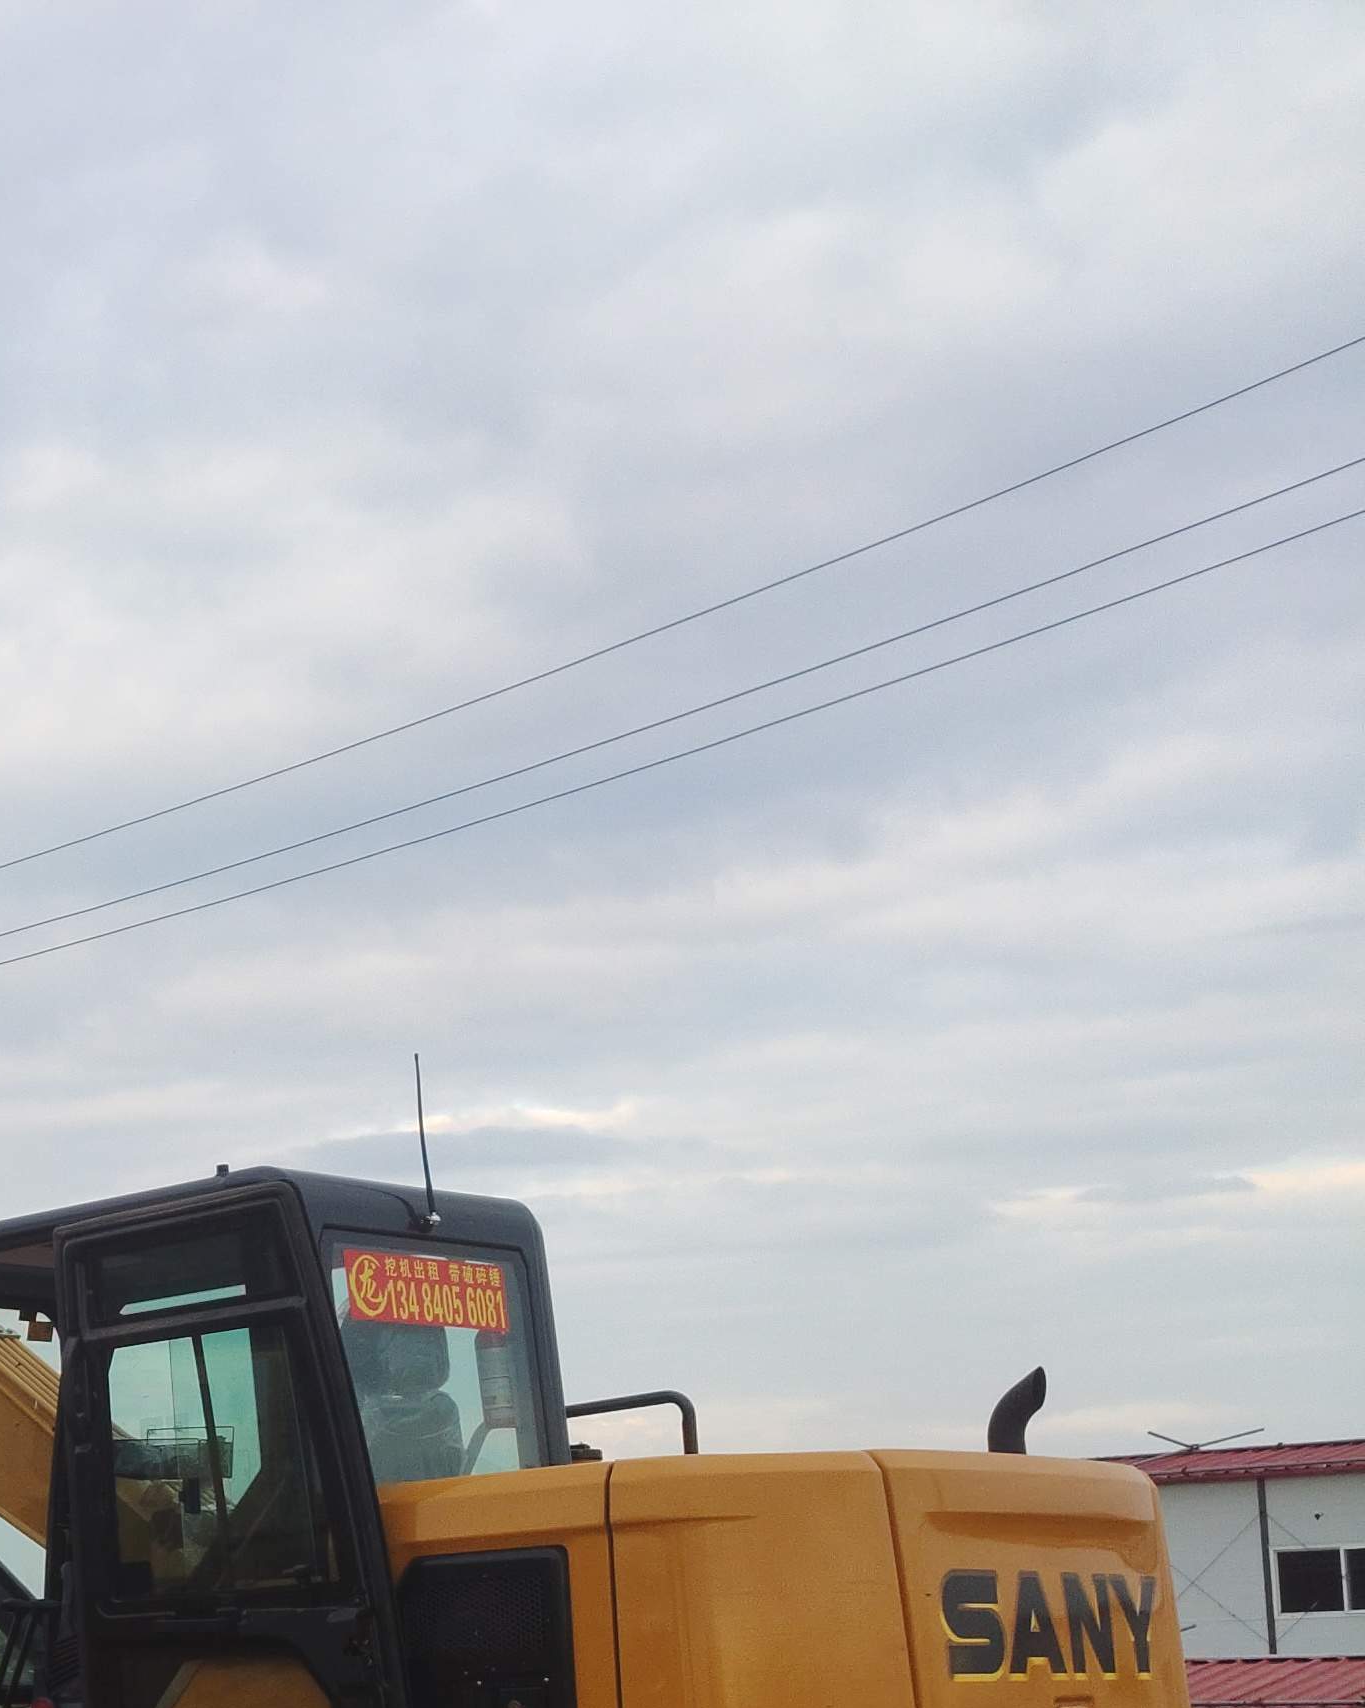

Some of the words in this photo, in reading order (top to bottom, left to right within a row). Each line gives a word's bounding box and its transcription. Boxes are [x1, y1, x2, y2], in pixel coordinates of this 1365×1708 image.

[385, 1256, 440, 1280] 挖机出租
[386, 1279, 420, 1321] 134
[422, 1282, 464, 1325] 8405
[466, 1287, 506, 1329] 6081
[940, 1569, 1156, 1681] SANY
